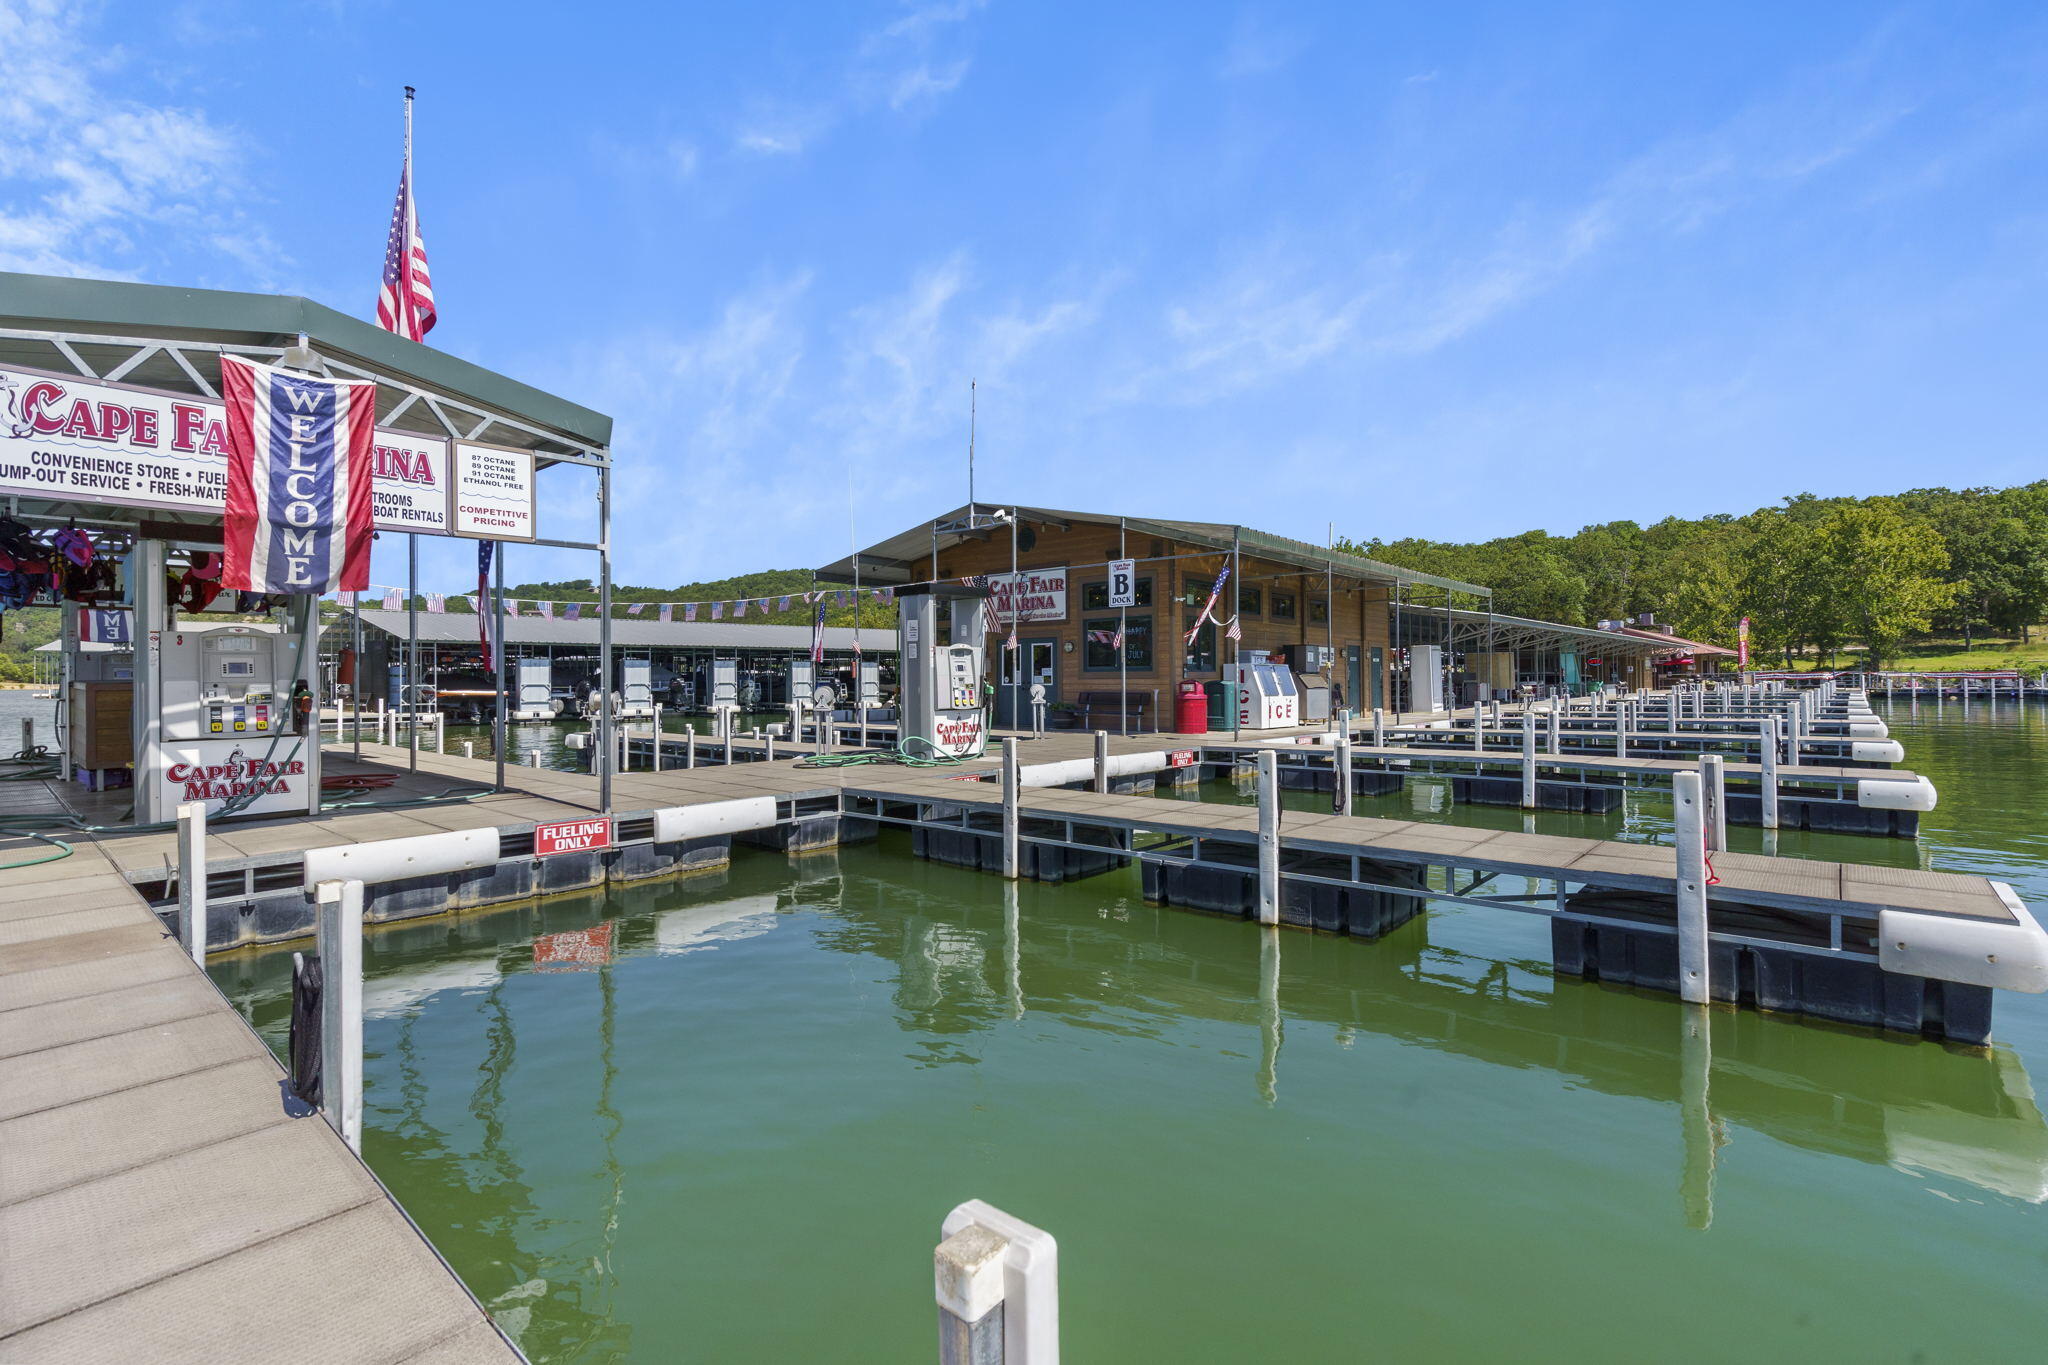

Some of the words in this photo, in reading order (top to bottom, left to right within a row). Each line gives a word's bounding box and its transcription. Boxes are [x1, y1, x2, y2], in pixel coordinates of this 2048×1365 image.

[22, 381, 159, 448] CAPE
[171, 402, 229, 458] FA
[372, 445, 436, 486] INA
[471, 454, 483, 462] 87
[483, 456, 516, 466] OCTANE
[471, 462, 483, 470] 89
[483, 464, 516, 474] OCTANE
[31, 450, 133, 476] CONVENIENCE
[137, 463, 180, 481] STORE
[198, 470, 228, 486] FUEL
[373, 491, 413, 507] TROOMS
[282, 385, 325, 585] WELCOME
[463, 477, 502, 488] ETHANOL
[504, 482, 524, 490] FREE
[483, 472, 516, 482] OCTANE
[0, 463, 67, 484] UMP-OUT
[71, 471, 130, 491] SERVICE
[150, 480, 228, 501] FRESH-WATE
[373, 505, 399, 519] BOAT
[402, 508, 444, 524] RENTALS
[459, 505, 529, 520] COMPETITIVE
[473, 516, 516, 528] PRICING
[1028, 575, 1065, 594] FAIR
[1113, 573, 1129, 596] B
[996, 594, 1057, 613] MARINA
[1112, 596, 1131, 604] DOCK
[177, 634, 183, 646] 3
[1268, 704, 1292, 719] ICE
[166, 763, 239, 784] CAPE
[245, 758, 306, 779] FAIR
[183, 778, 291, 801] MARINA
[543, 822, 604, 840] FUELING
[554, 835, 594, 851] ONLY
